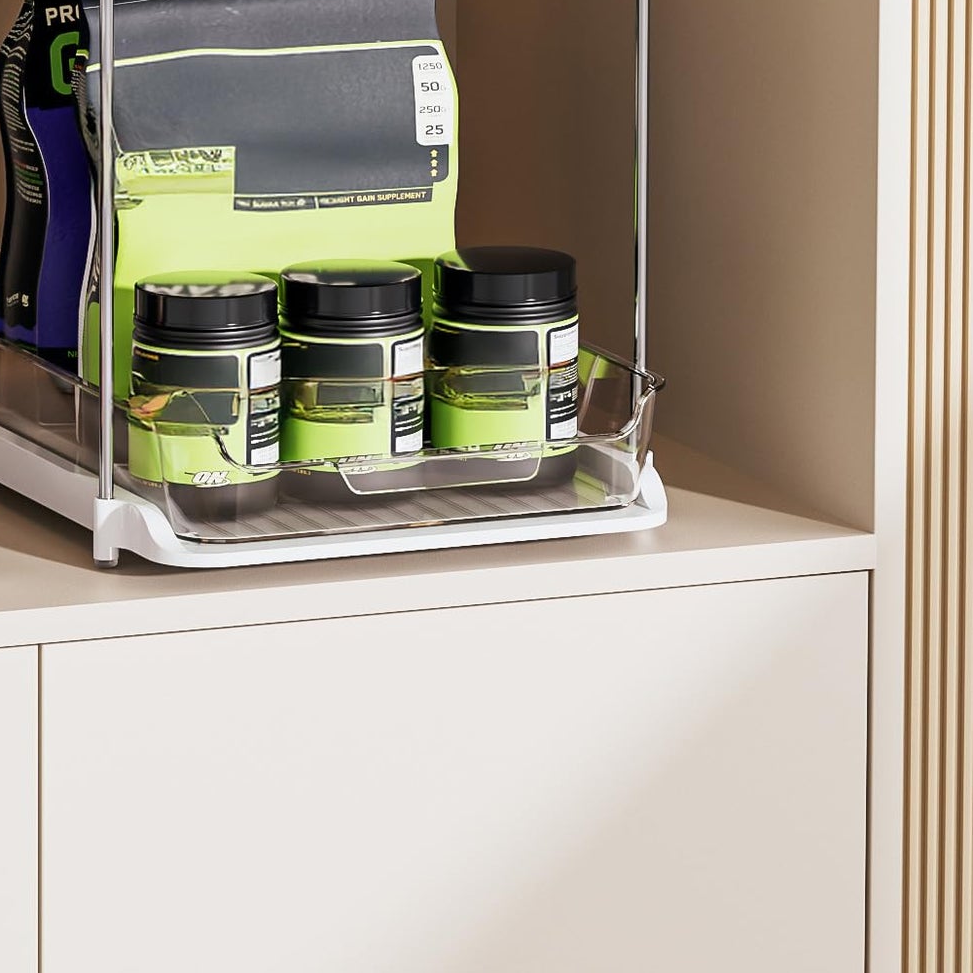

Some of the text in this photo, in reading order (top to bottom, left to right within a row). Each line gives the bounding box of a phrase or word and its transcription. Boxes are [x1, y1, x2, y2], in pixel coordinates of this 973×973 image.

[418, 62, 443, 71] 1250
[425, 124, 444, 135] 25
[356, 193, 376, 203] GAIN
[377, 191, 427, 201] SUPPLEMENT
